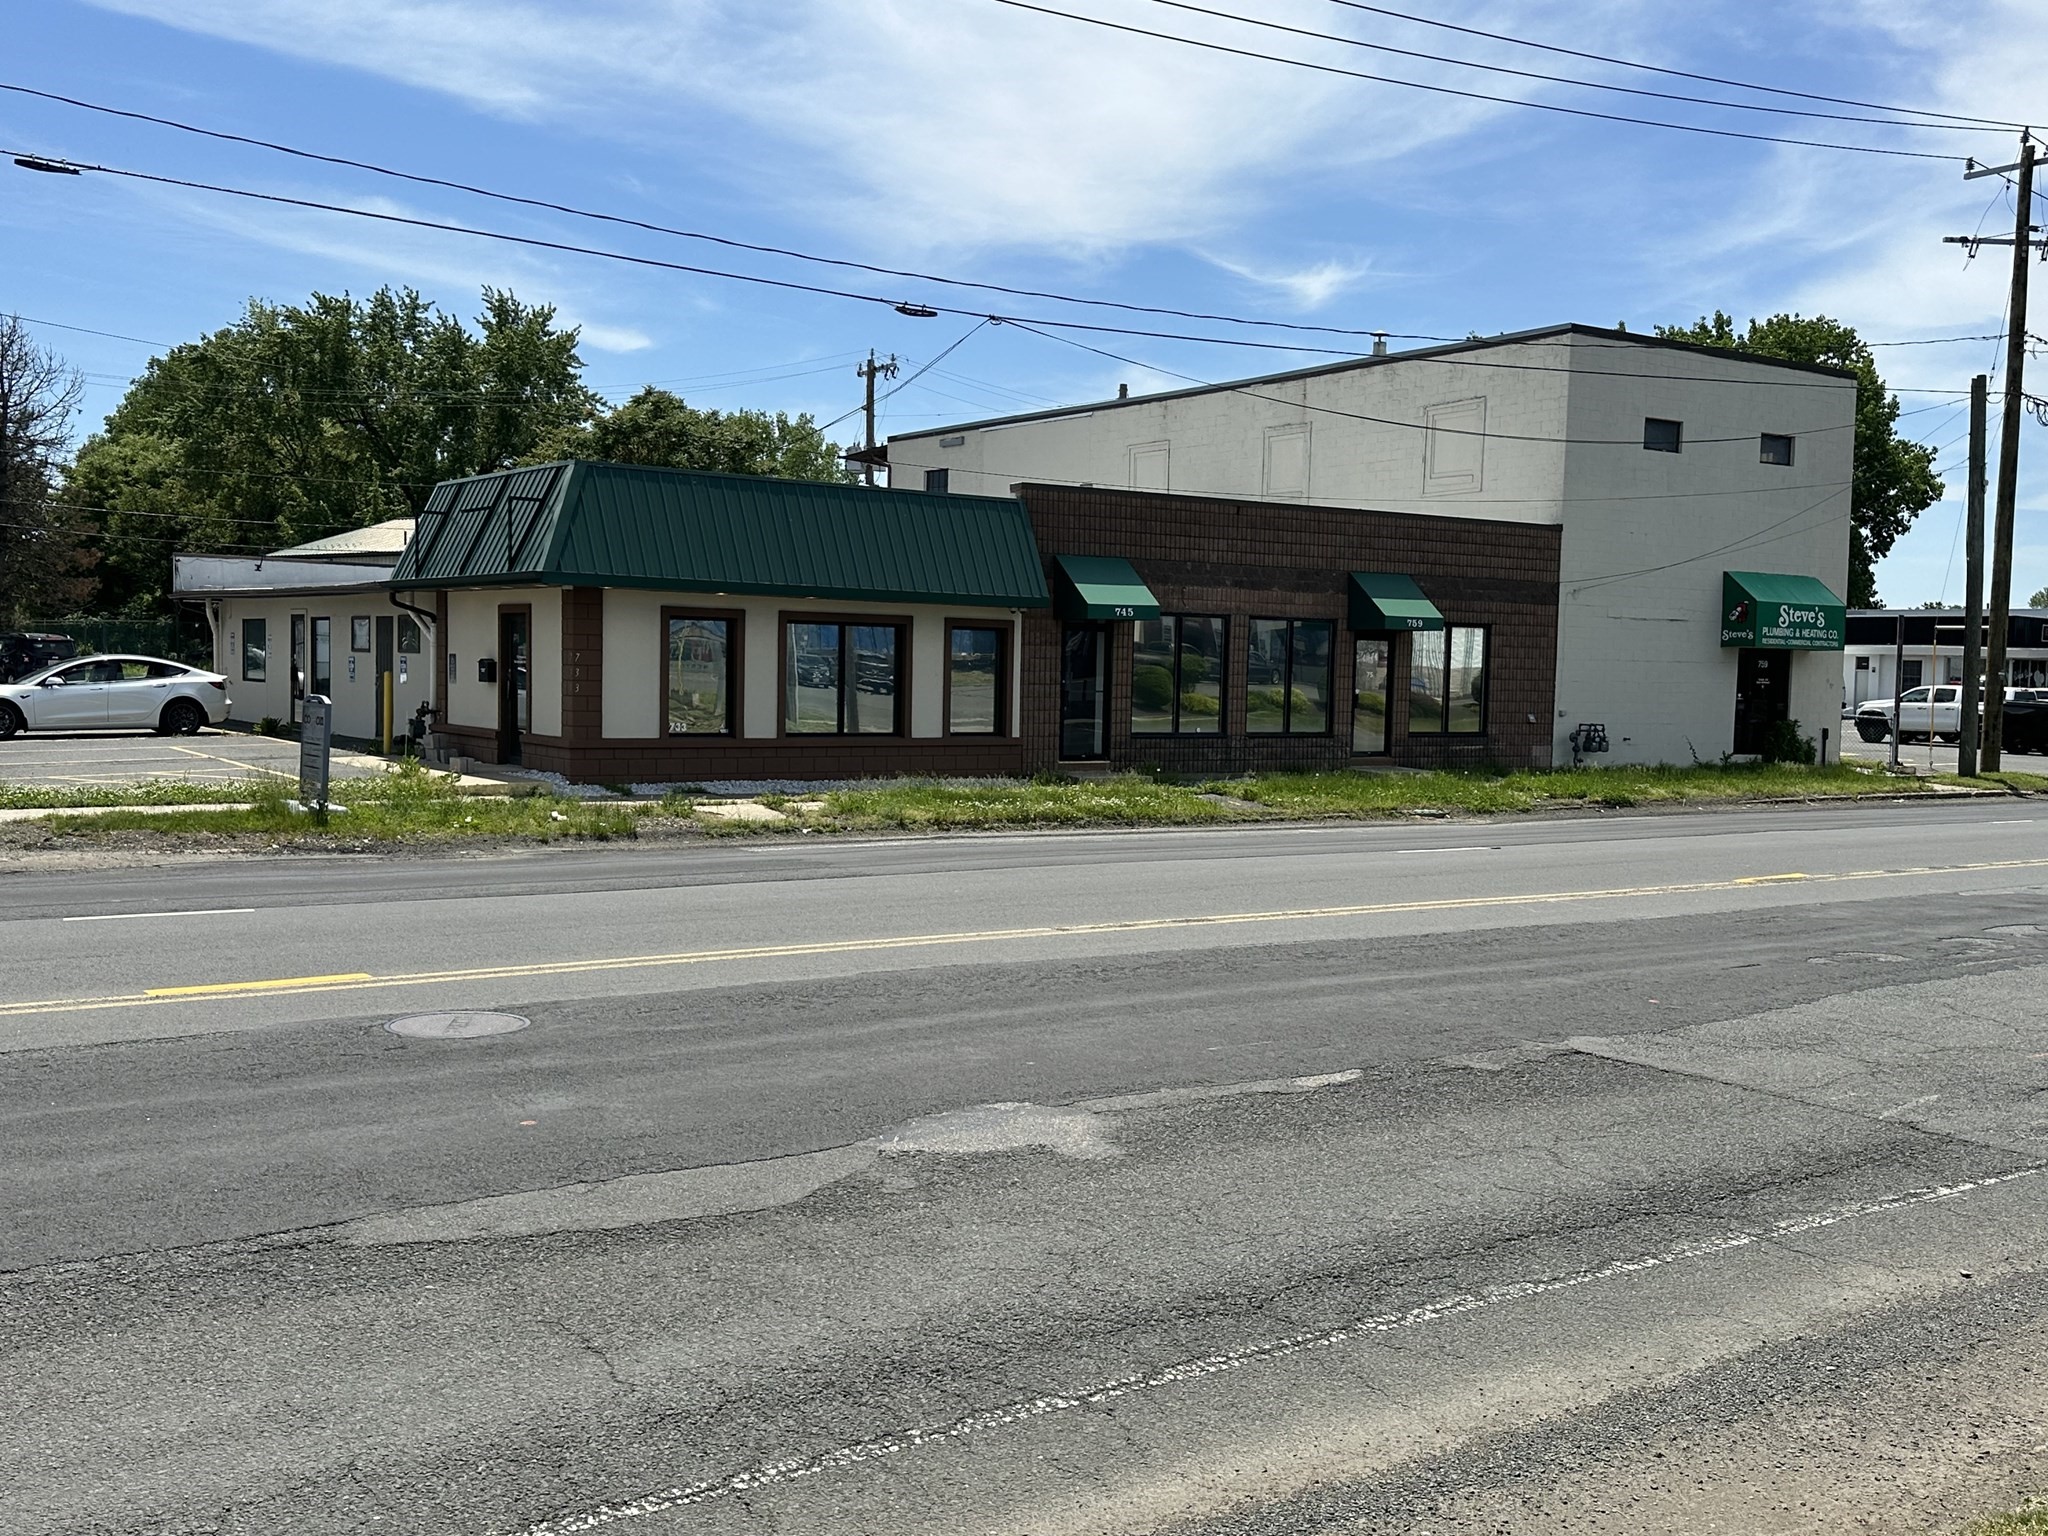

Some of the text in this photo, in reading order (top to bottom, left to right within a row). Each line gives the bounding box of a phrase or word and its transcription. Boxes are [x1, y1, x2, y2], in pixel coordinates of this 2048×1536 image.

[1114, 607, 1134, 617] 745
[1778, 605, 1825, 627] Steve's
[1406, 619, 1423, 628] 759
[1722, 629, 1754, 640] Steve's
[1762, 626, 1839, 640] PLUMBING & HEATING CO.
[1758, 660, 1768, 668] 759
[669, 722, 687, 732] 733
